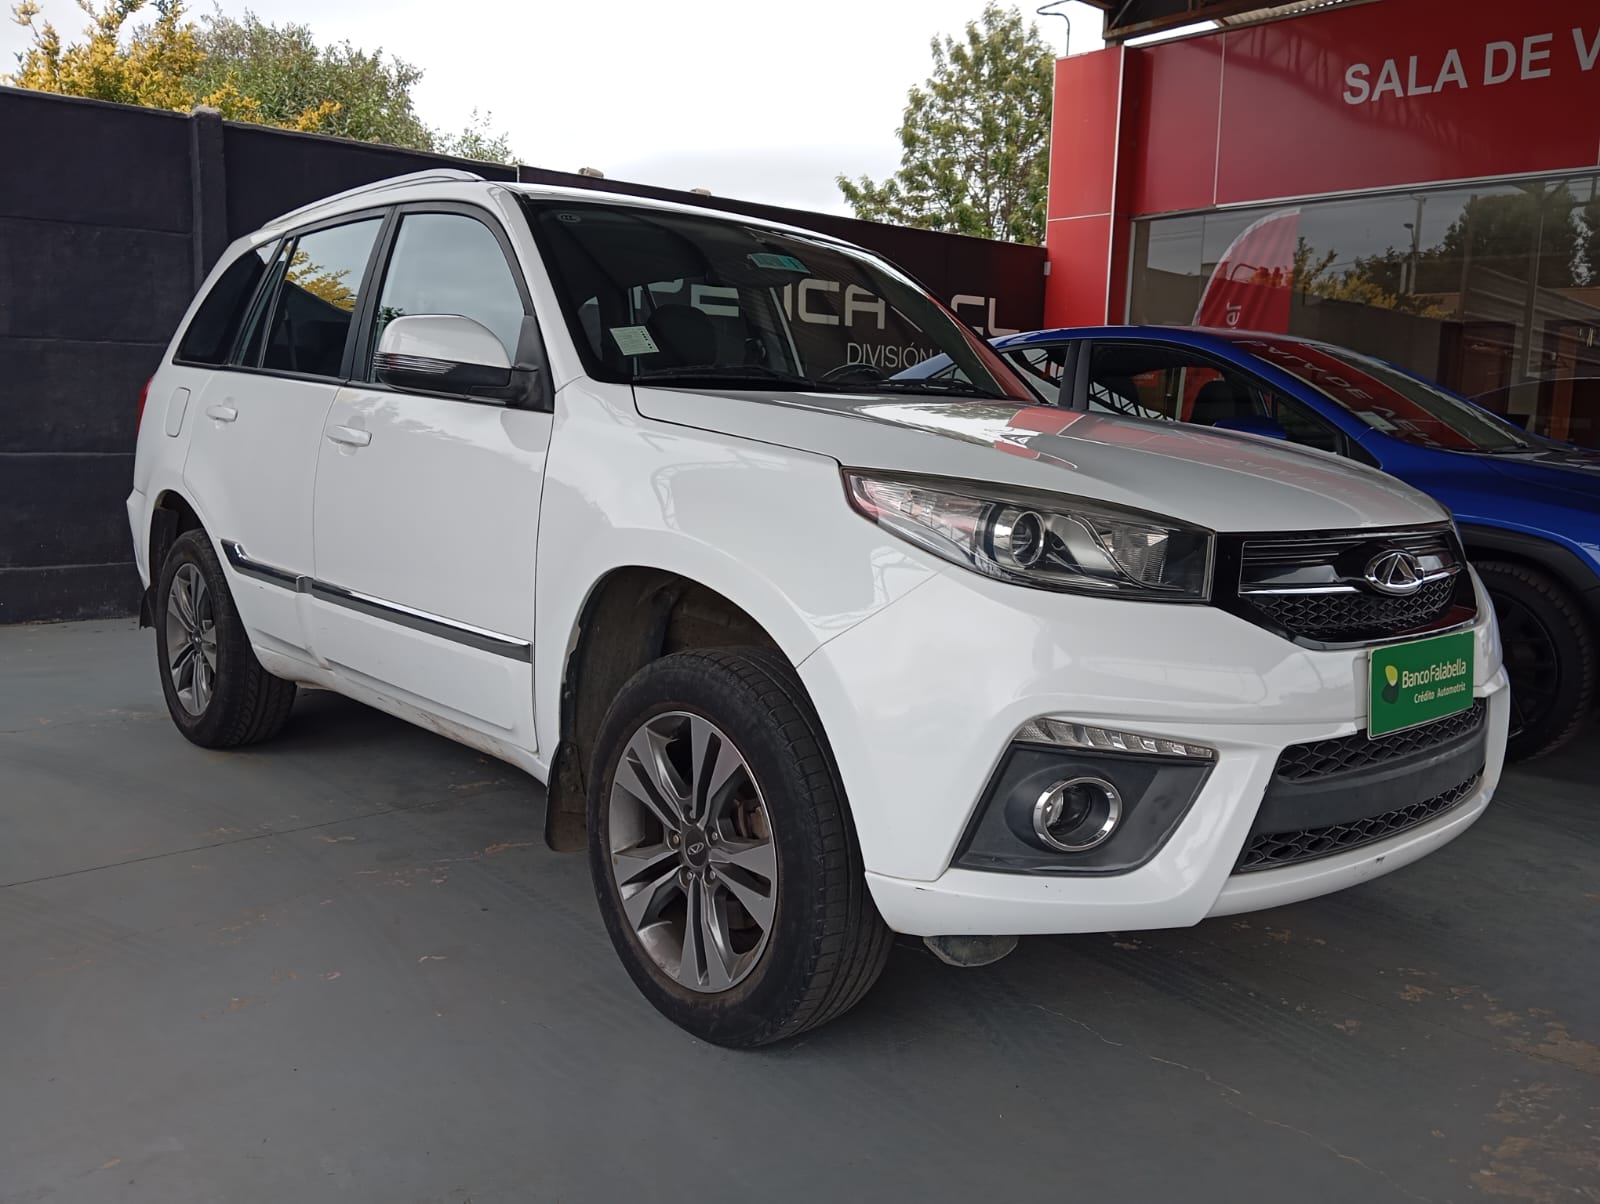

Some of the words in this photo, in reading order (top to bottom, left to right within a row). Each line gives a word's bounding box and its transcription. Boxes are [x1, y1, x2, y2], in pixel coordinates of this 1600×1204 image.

[1343, 48, 1468, 105] SALA
[1483, 32, 1553, 86] DE
[847, 342, 933, 369] DIVISIÓN
[1414, 690, 1436, 704] Crédito
[1437, 682, 1466, 698] Automotriz
